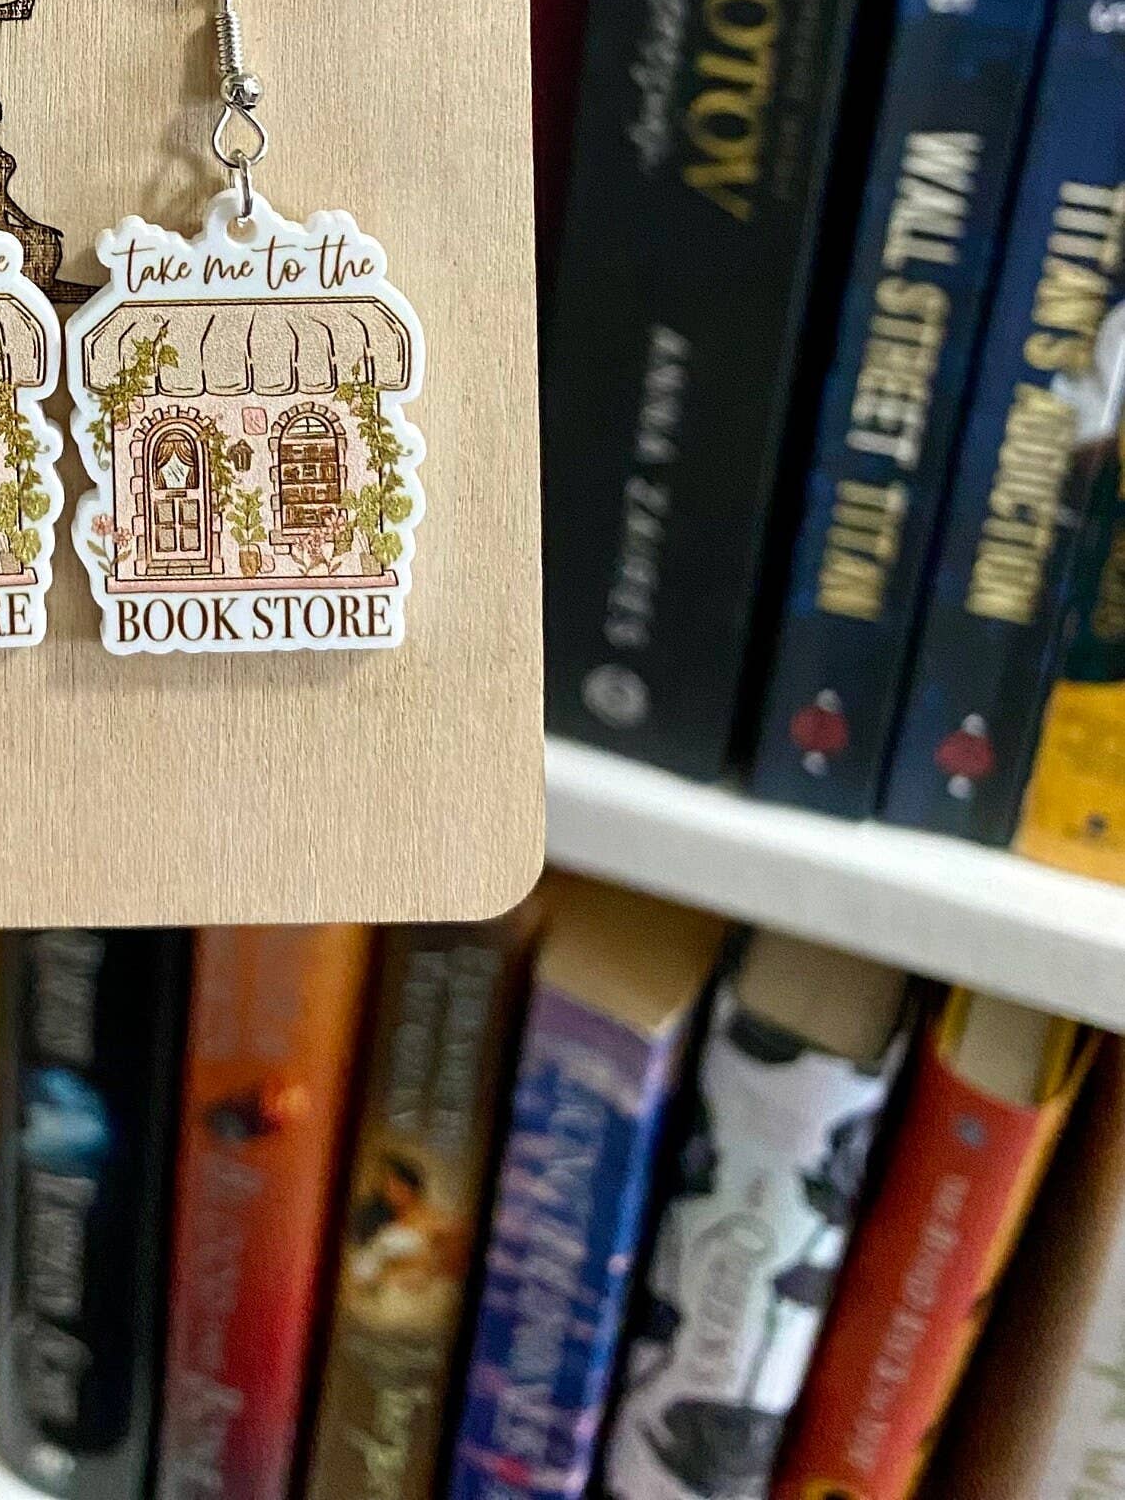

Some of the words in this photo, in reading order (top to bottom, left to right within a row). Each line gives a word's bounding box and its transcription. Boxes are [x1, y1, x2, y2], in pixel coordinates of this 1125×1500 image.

[111, 239, 192, 294] take
[203, 255, 254, 285] me
[251, 236, 307, 290] to
[304, 234, 374, 290] the
[882, 131, 982, 269] WALL
[846, 278, 950, 470] STREET
[116, 597, 243, 643] BOOK
[252, 594, 393, 641] STORE
[814, 479, 909, 621] TITAN
